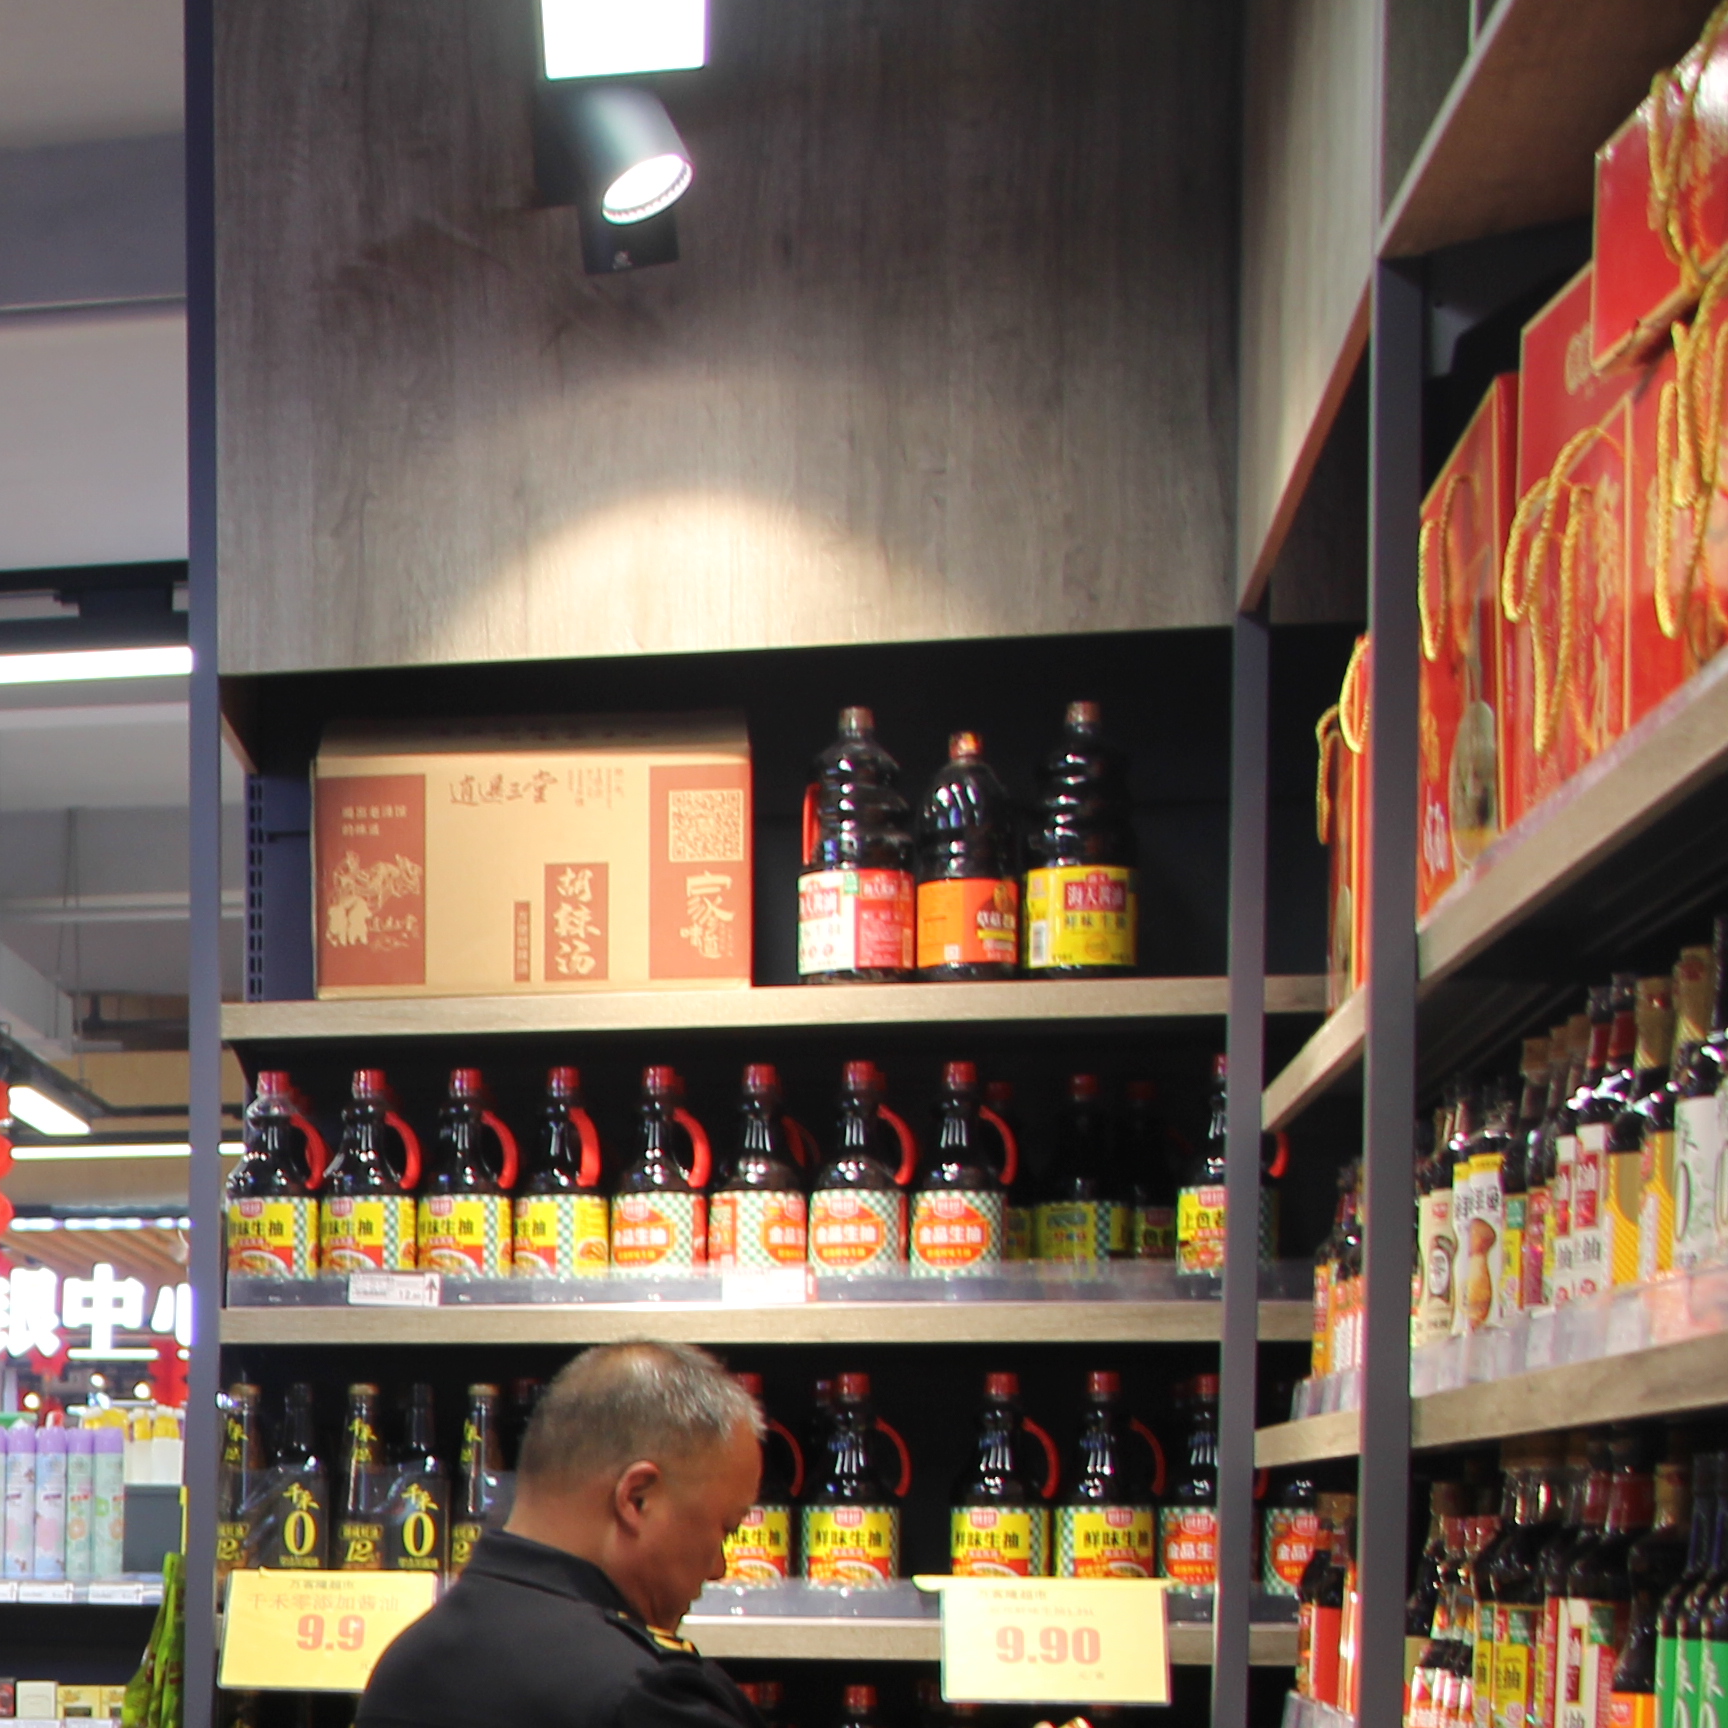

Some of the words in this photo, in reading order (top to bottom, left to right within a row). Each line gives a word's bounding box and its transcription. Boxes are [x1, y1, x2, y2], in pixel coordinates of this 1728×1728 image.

[554, 865, 601, 976] 胡辣汤
[812, 1223, 878, 1246] 金品生抽
[918, 1224, 983, 1246] 金品生抽
[283, 1510, 317, 1556] 0
[402, 1510, 436, 1556] 0
[814, 1528, 883, 1549] 鲜味生抽
[296, 1614, 365, 1651] 9.9
[995, 1625, 1102, 1666] 9.90
